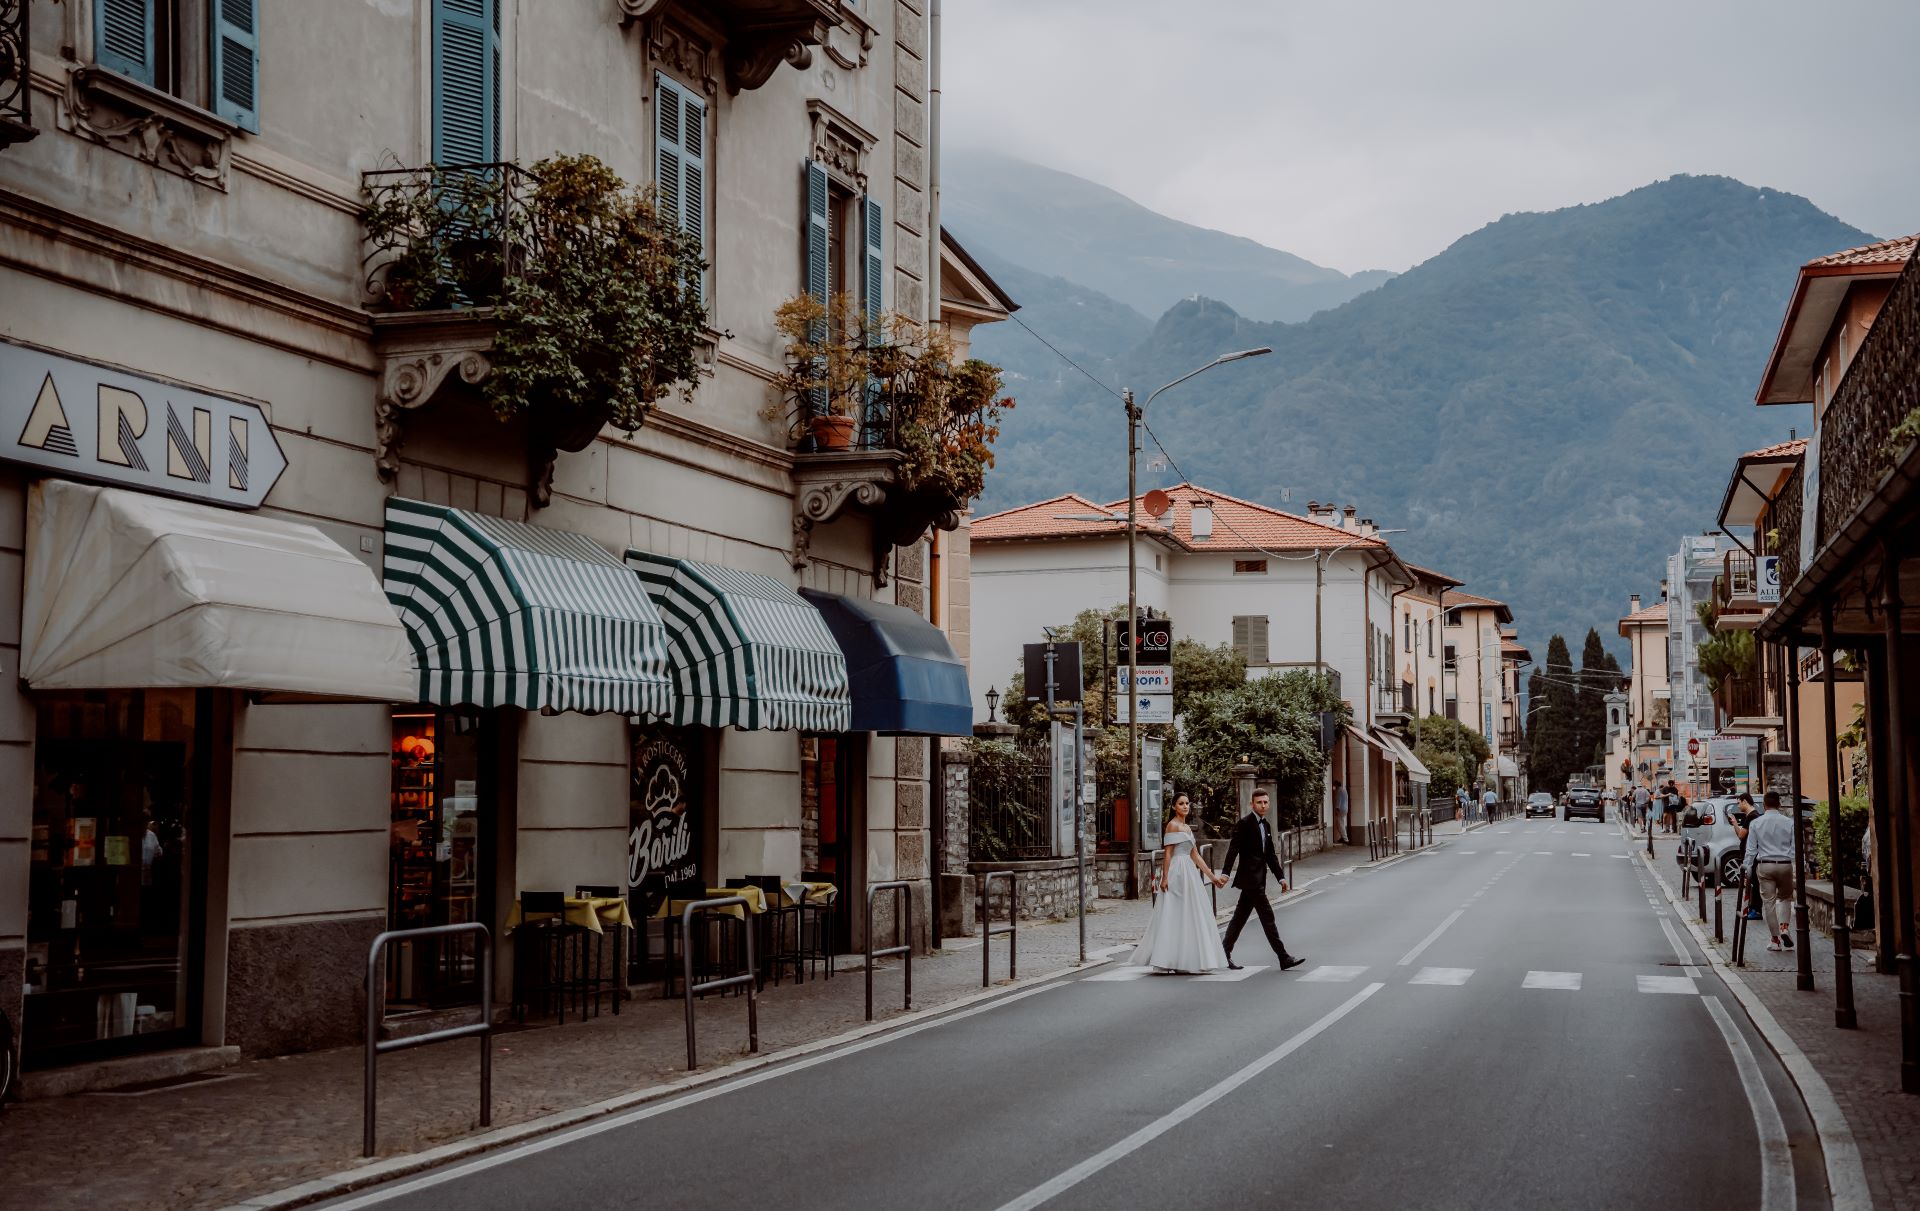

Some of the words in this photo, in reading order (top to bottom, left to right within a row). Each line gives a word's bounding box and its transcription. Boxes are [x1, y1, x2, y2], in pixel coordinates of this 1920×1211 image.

[1688, 742, 1699, 751] STOP
[642, 740, 688, 781] ROSTICCERIA
[680, 863, 697, 881] 1960
